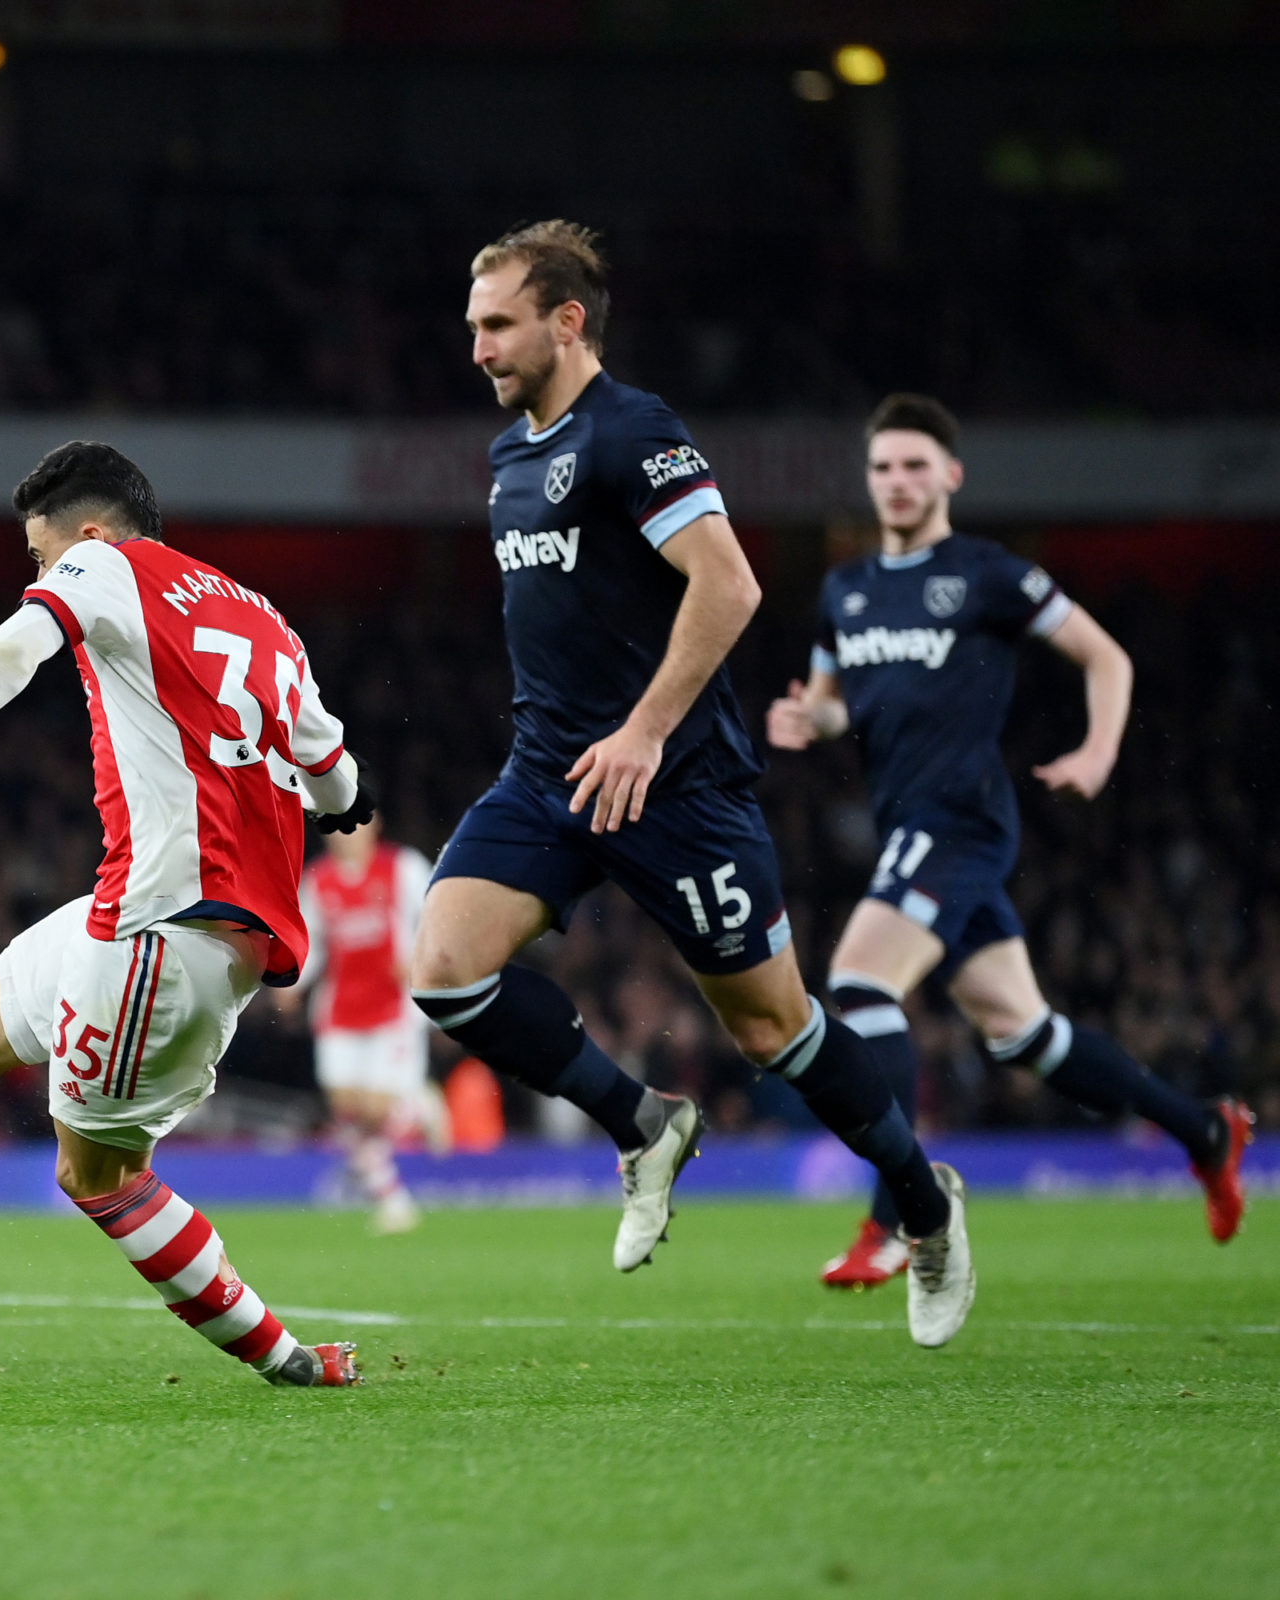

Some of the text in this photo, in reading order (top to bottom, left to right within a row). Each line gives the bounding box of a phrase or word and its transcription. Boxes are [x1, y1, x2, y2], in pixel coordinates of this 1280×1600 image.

[494, 526, 580, 572] etway
[193, 626, 302, 794] 35
[675, 861, 752, 935] 15
[52, 999, 110, 1081] 35
